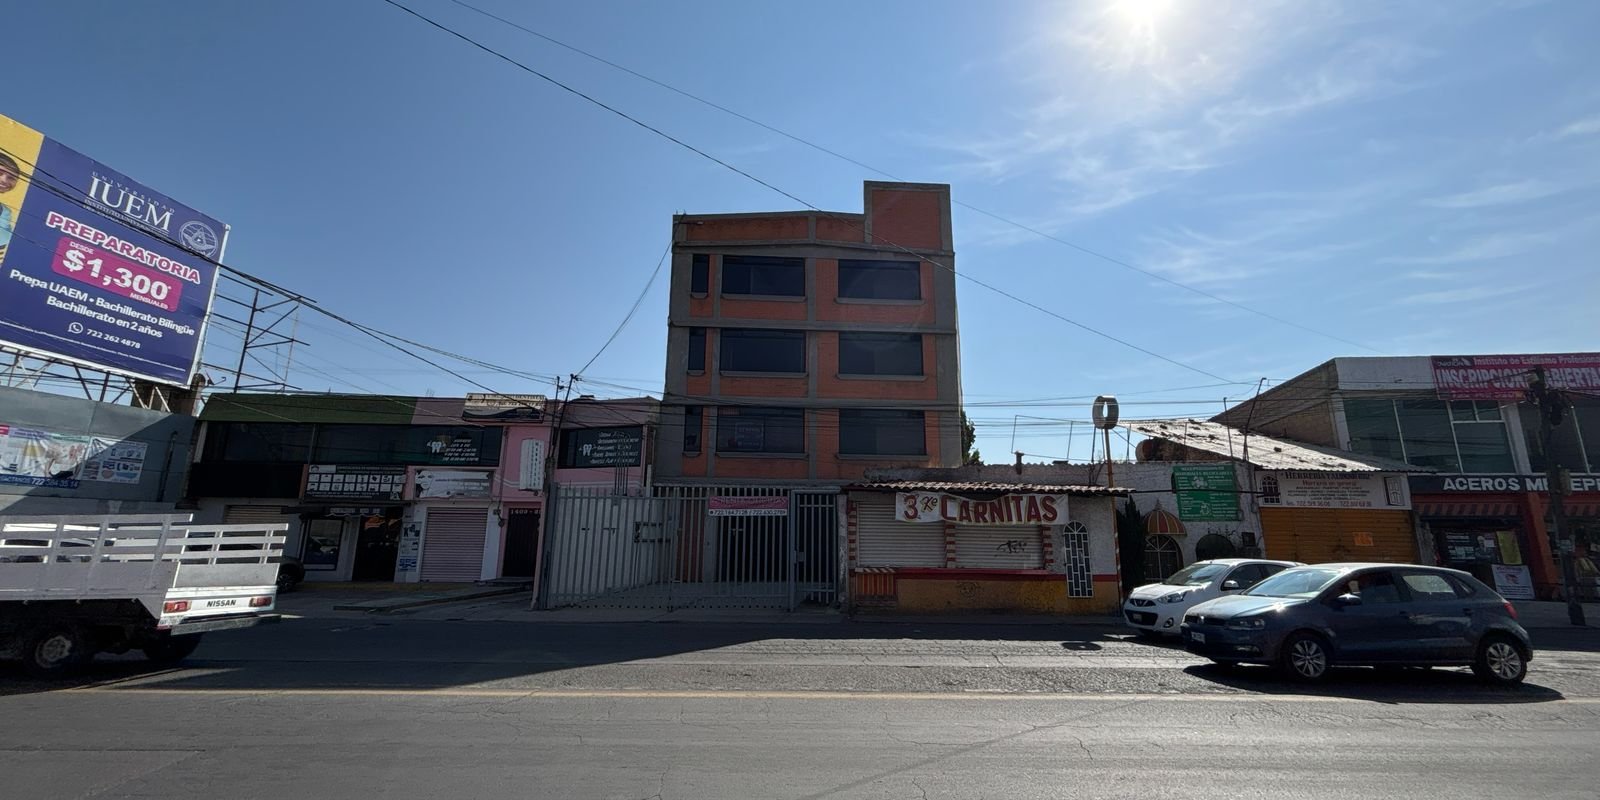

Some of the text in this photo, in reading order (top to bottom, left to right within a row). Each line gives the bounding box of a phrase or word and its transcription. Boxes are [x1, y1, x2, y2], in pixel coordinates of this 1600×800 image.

[88, 175, 173, 232] IUEM
[92, 172, 175, 213] UNIVERSIDAD
[46, 211, 201, 285] PREPARATORIA
[69, 241, 95, 255] DESDE
[9, 269, 195, 338] Prepa UAEM Bachillerato Bilingüe
[130, 293, 169, 310] MENSUALES
[46, 296, 164, 340] Bachillerato en 2 años
[86, 327, 142, 350] 722 262 4878
[1443, 478, 1521, 492] ACEROS
[941, 494, 1058, 523] CARNITAS
[207, 600, 237, 608] NISSAN
